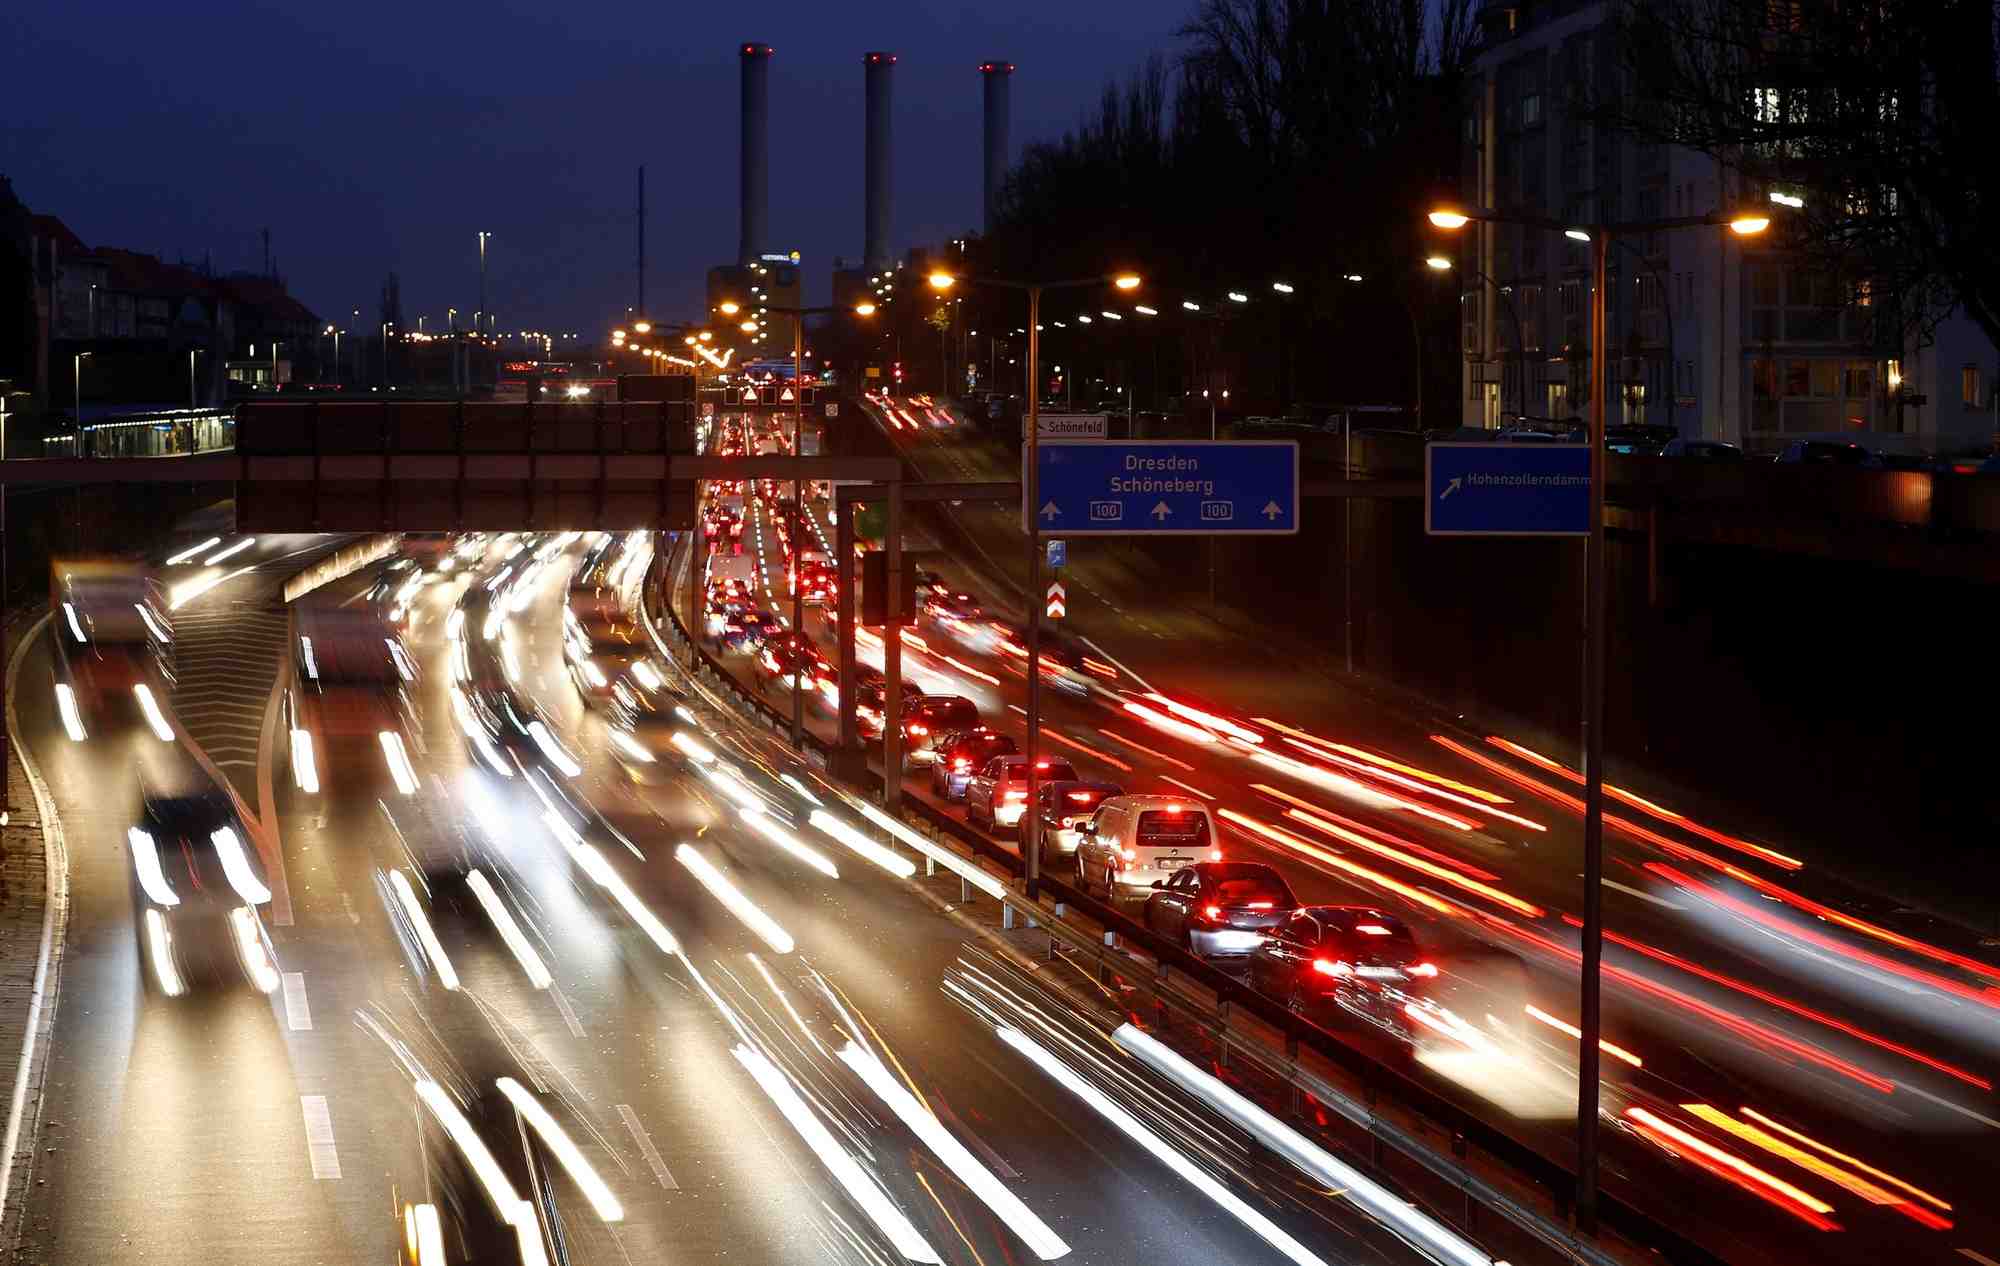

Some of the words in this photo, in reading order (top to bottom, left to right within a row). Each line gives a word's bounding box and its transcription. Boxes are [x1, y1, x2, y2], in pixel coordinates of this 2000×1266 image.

[1048, 420, 1103, 433] Schönefeld
[1125, 454, 1199, 471] Dresden
[1110, 476, 1215, 496] Schöneberg
[1096, 504, 1118, 518] 100
[1206, 504, 1228, 518] 100
